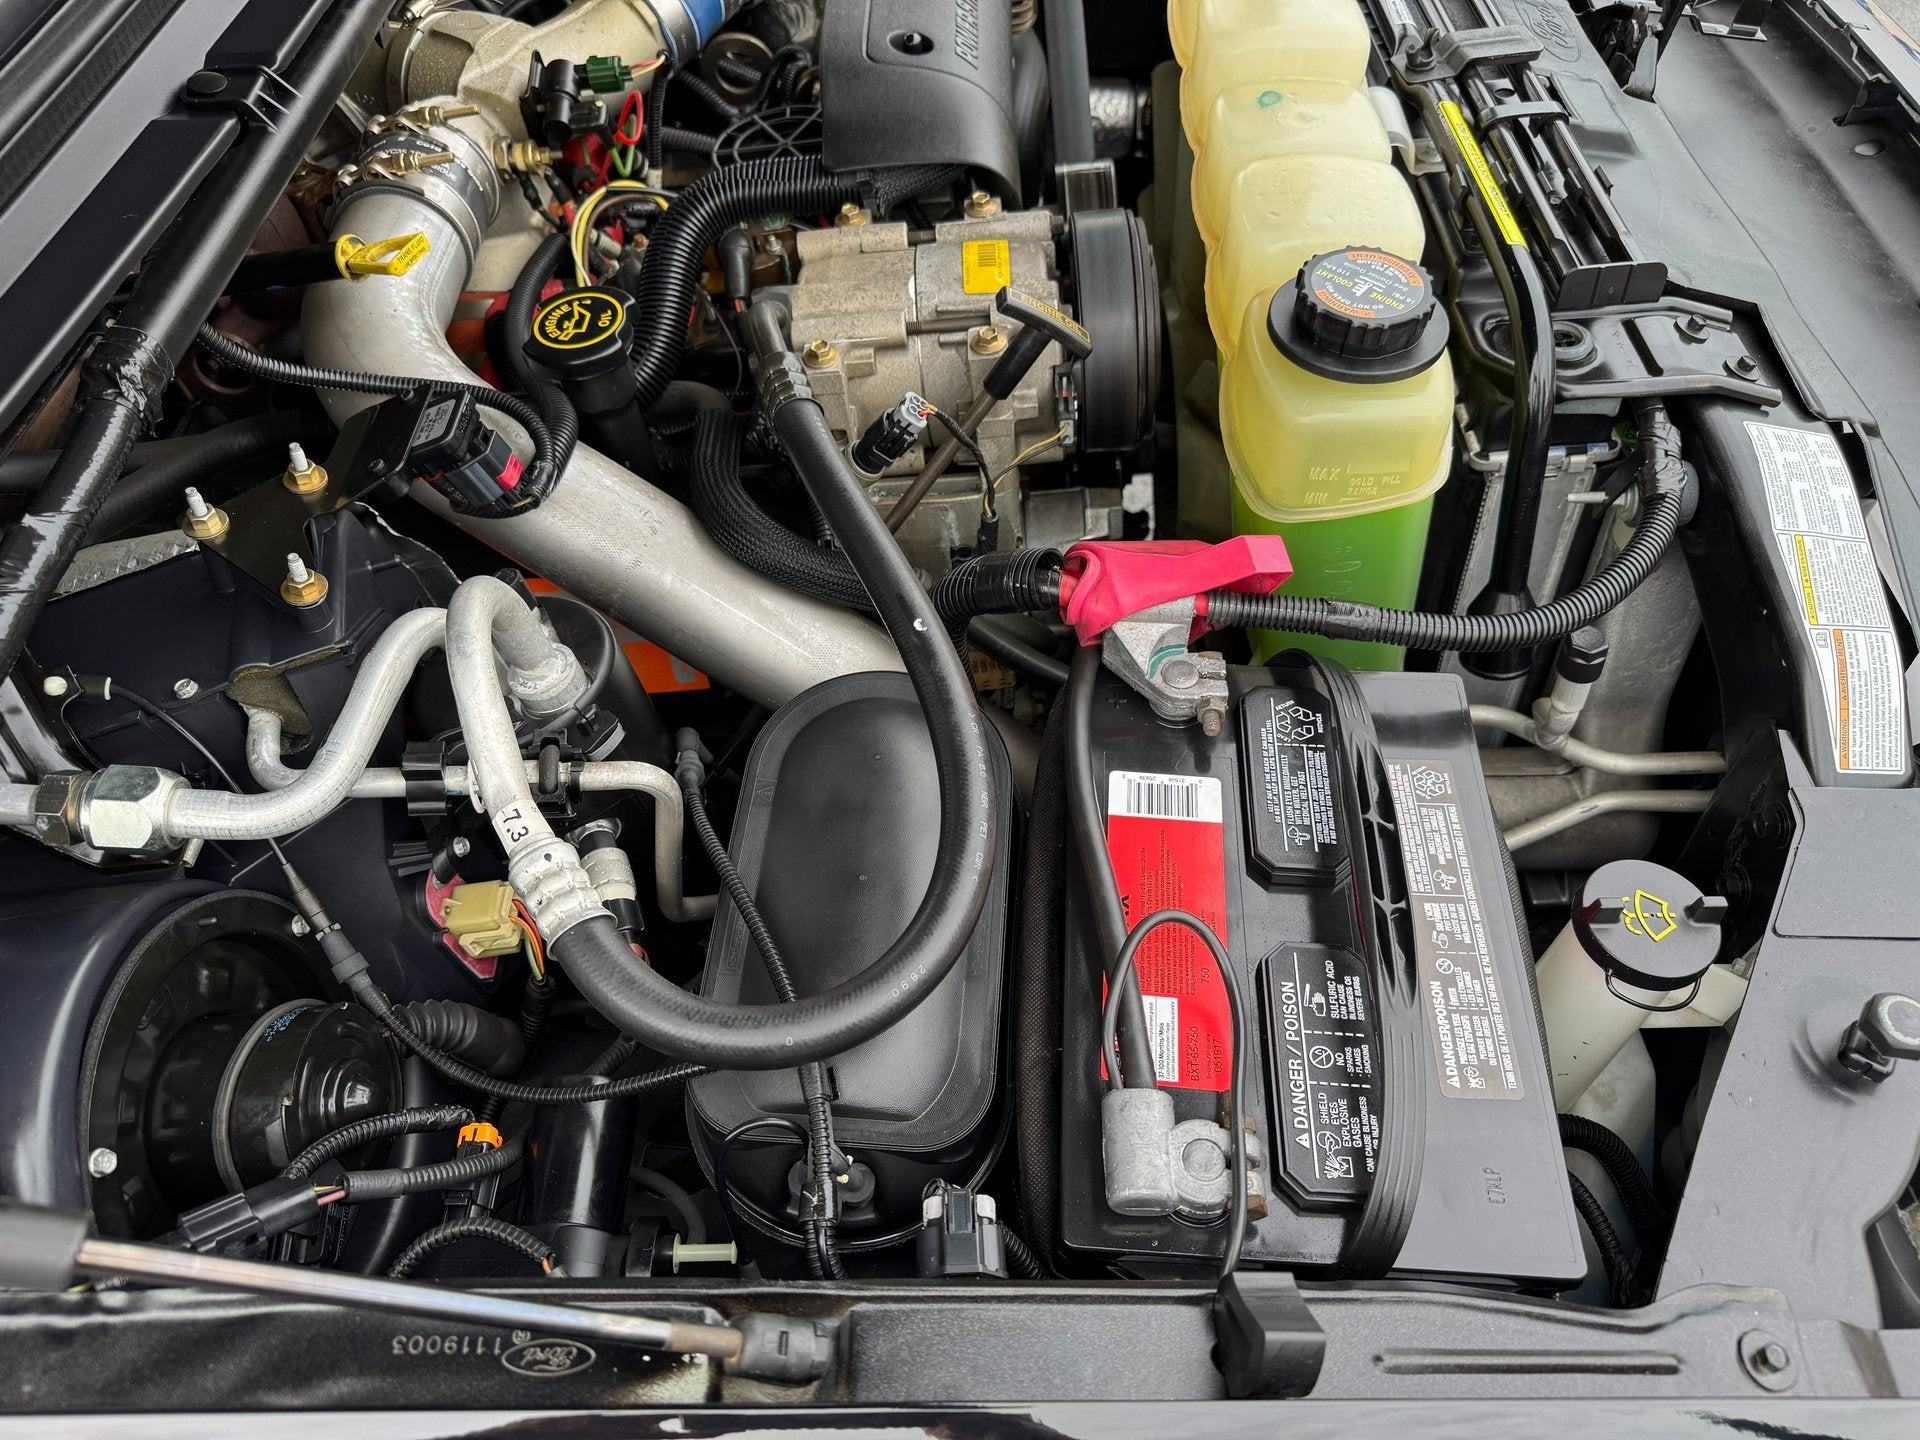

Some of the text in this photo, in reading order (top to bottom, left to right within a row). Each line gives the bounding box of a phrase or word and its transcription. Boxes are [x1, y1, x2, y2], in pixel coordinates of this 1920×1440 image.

[397, 248, 411, 265] TRANS
[410, 235, 425, 251] FLUID
[1343, 261, 1367, 274] Guide
[1367, 271, 1392, 285] Owner
[1316, 269, 1404, 311] ENGINE COOLANT
[1319, 290, 1358, 316] WARNING
[1333, 293, 1351, 305] OPEN
[1392, 291, 1406, 300] PSI
[598, 309, 612, 328] OIL
[1020, 293, 1083, 335] ENGINE OIL
[1353, 302, 1370, 310] NOT
[545, 303, 572, 339] ENGINE
[1310, 467, 1340, 480] MAX
[1350, 475, 1400, 487] COLD FILL
[1304, 492, 1328, 504] MIN
[1808, 548, 1817, 576] INSTRUCTIONS
[1837, 638, 1847, 694] AVERTISSEMENT
[1316, 713, 1324, 733] RECYCLE
[1281, 754, 1295, 825] FLUSH EYES IMMEDIATELY
[1290, 776, 1298, 787] GET
[1297, 771, 1311, 826] MEDICAL HELP FAST
[503, 808, 529, 843] 7.3
[979, 820, 988, 839] PET
[1294, 810, 1303, 825] WITH
[892, 963, 927, 999] 2890
[1201, 967, 1210, 984] 750
[1325, 960, 1340, 1019] SULFURIC ACID
[1337, 984, 1346, 1005] CAUSE
[1344, 976, 1357, 1020] BLINDNESS OR
[1352, 976, 1365, 1021] SEVERE BURNS
[1475, 922, 1517, 1089] TENIR HORS DE LA PORTÉE DES ENFANTS. NE PAS RENVERSER.
[1281, 981, 1300, 1042] POISON
[1451, 1013, 1461, 1026] YEUX
[1429, 981, 1458, 1076] DANGER/POISON
[1454, 1027, 1464, 1038] LES
[1461, 1015, 1478, 1065] LES GAZ EXPLOSIFS
[1472, 1015, 1487, 1060] PEUVENT BLESSER
[1480, 1015, 1497, 1066] OU RENDRE AVEUGLE
[1190, 1026, 1200, 1082] BXT-65-750
[1213, 1038, 1223, 1073] 051917
[1335, 1054, 1345, 1066] NO
[1345, 1047, 1354, 1072] SPARKS
[1353, 1048, 1363, 1073] FLAMES
[1361, 1045, 1372, 1073] SMOKING
[1289, 1060, 1309, 1129] DANGER
[1318, 1093, 1329, 1124] SHIELD
[1329, 1102, 1340, 1125] EYES
[1338, 1099, 1351, 1147] EXPLOSIVE
[1370, 1115, 1379, 1137] INJURY
[1350, 1117, 1362, 1148] GASES
[1359, 1097, 1374, 1172] CAN CAUSE BLINDNESS
[391, 1334, 502, 1356] 1119003
[521, 1346, 578, 1371] Ford
